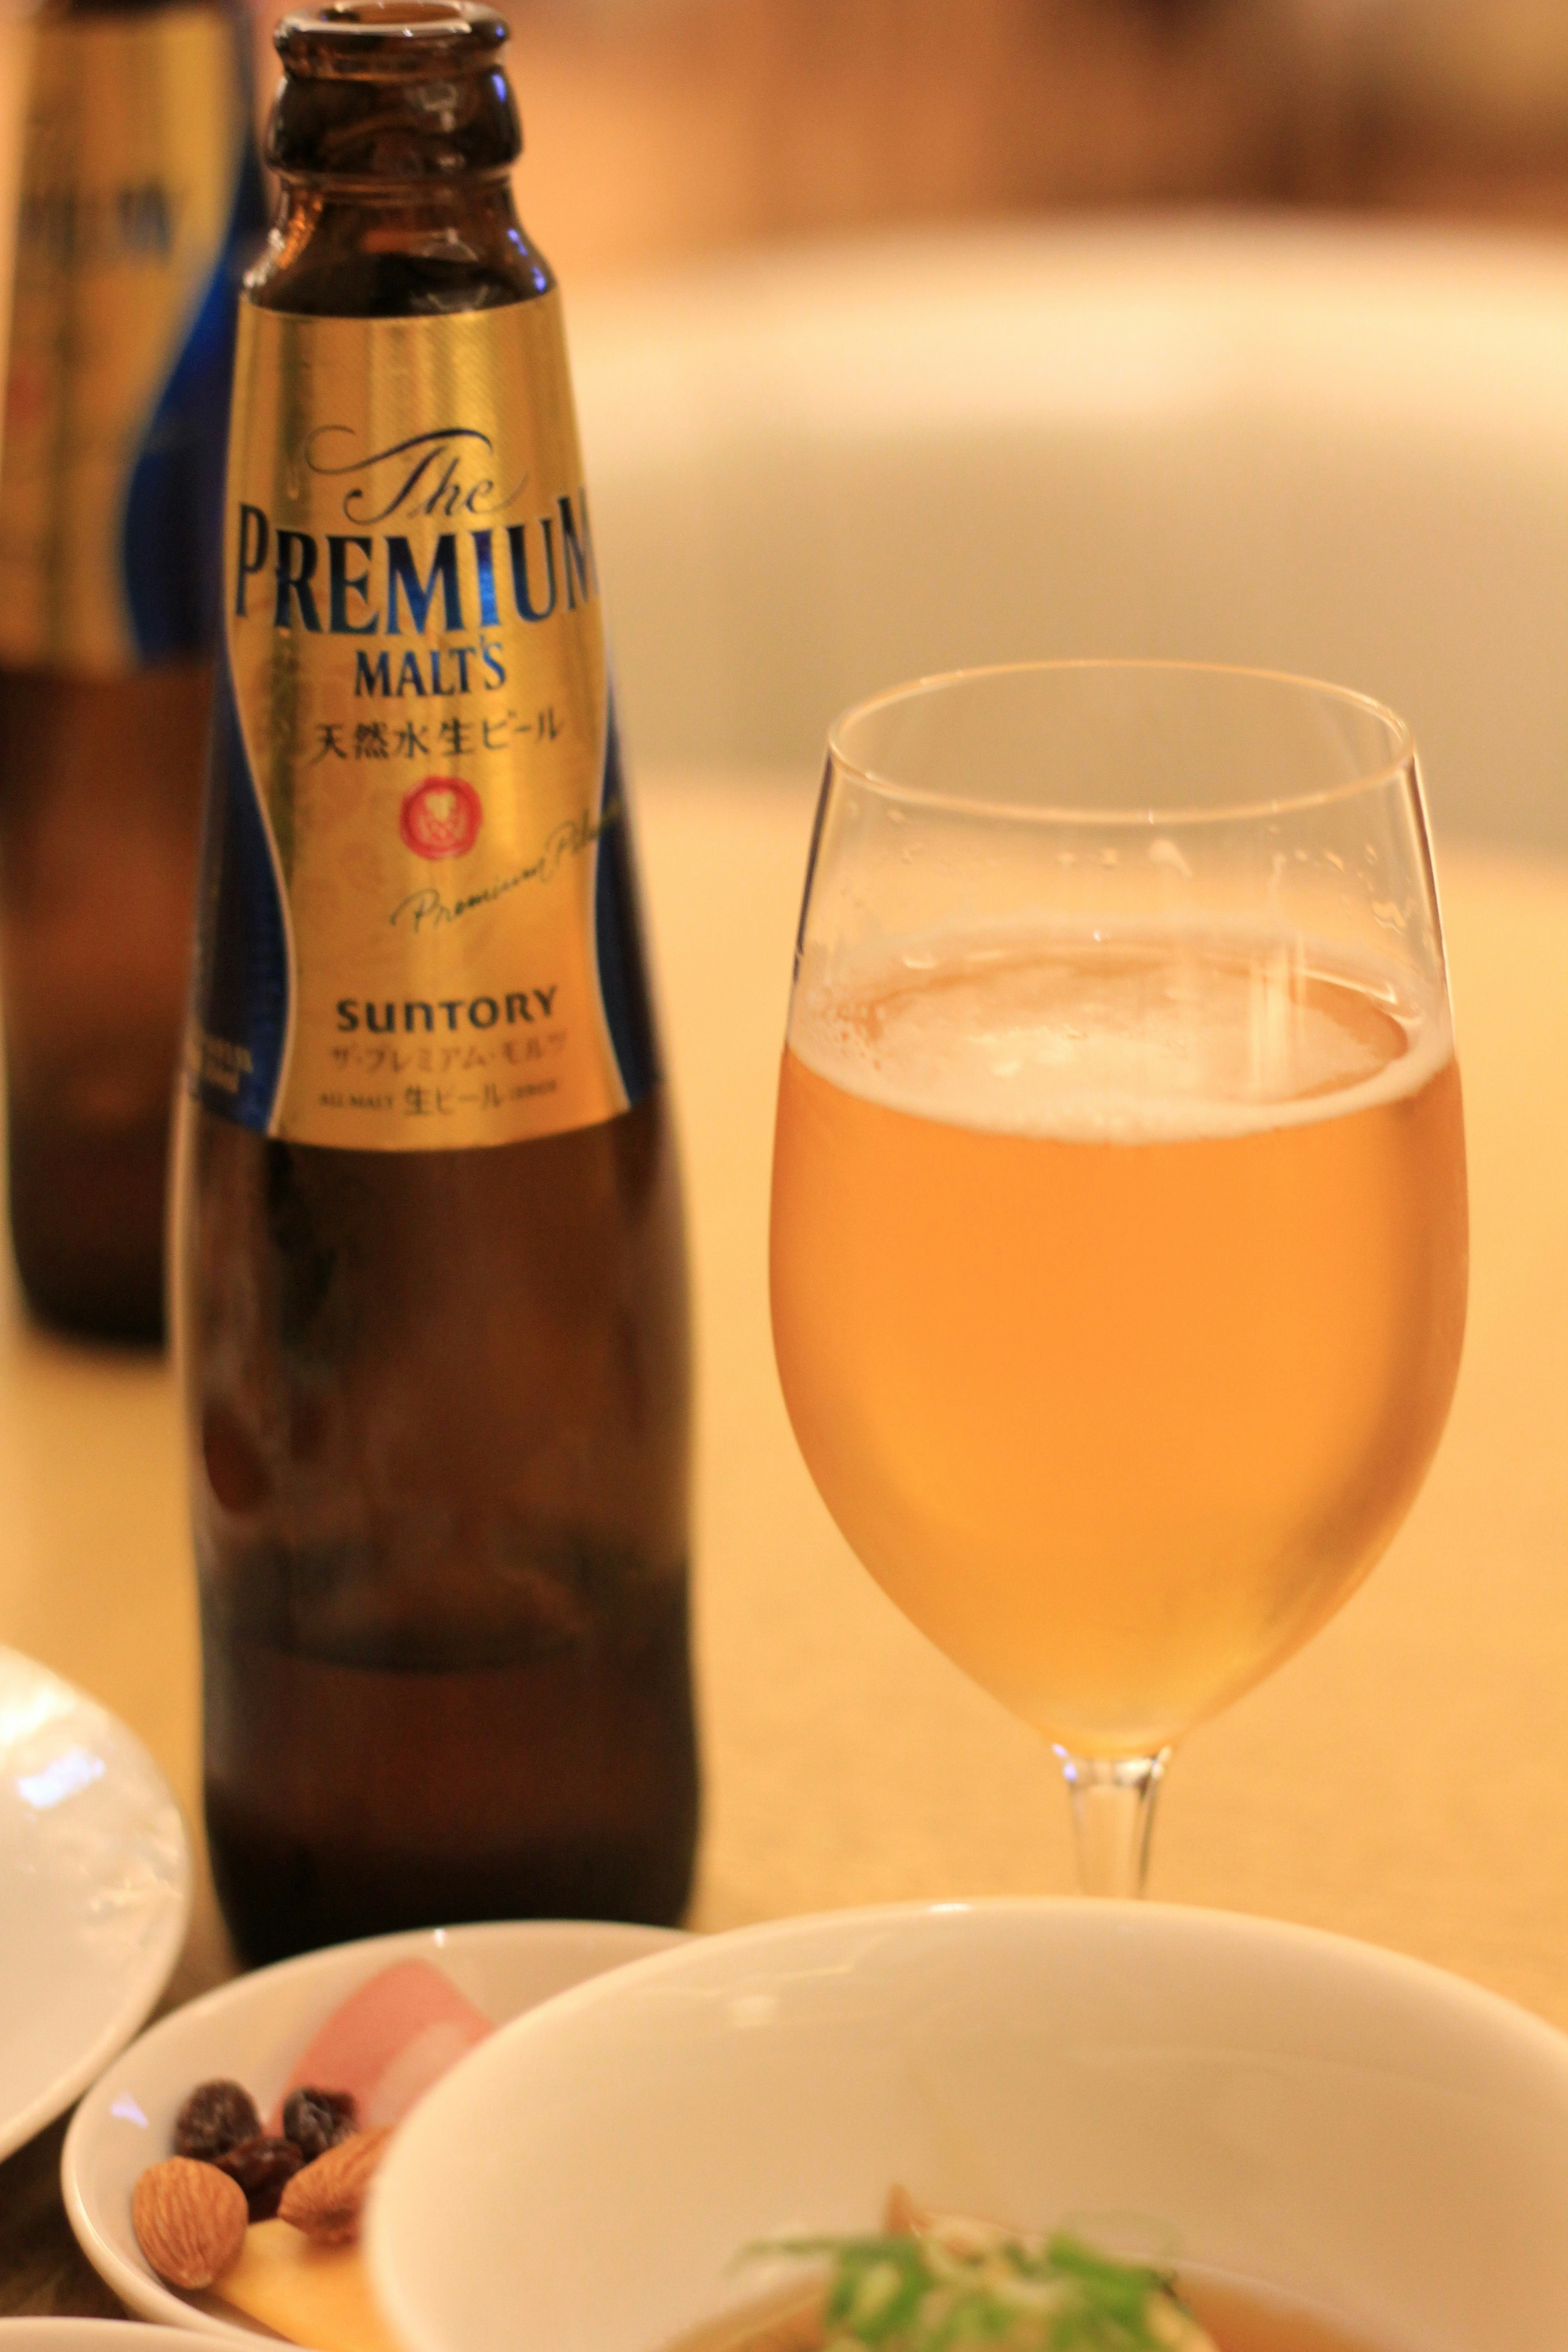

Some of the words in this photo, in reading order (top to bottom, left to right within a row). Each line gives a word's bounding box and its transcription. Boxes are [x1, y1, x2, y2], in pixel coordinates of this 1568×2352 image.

[305, 425, 528, 525] The
[235, 486, 599, 634] PREMIUM
[354, 636, 506, 697] MALT'S
[310, 707, 562, 763] 天然水生ビール
[336, 985, 557, 1033] SUNTORY
